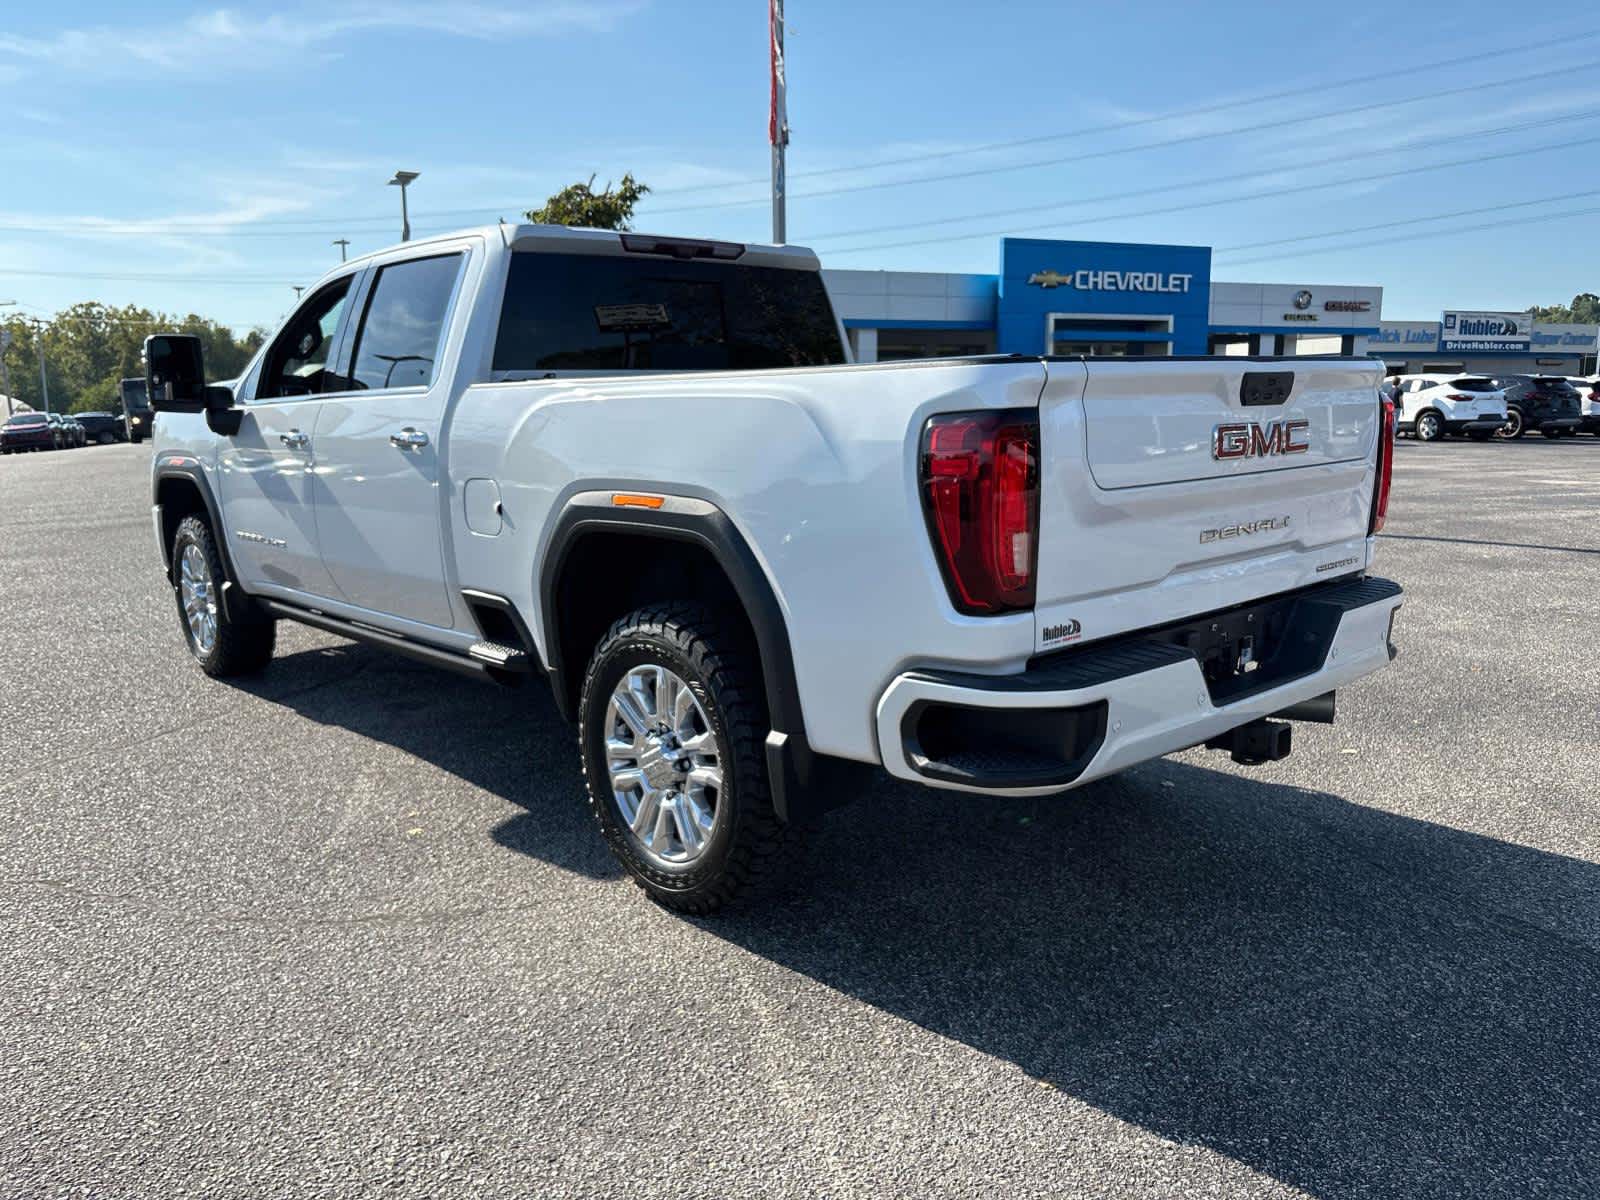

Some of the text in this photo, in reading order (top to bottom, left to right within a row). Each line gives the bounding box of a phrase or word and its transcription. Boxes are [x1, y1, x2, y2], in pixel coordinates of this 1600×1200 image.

[1074, 270, 1192, 293] CHEVROLET
[1459, 319, 1503, 336] Hubler
[1446, 341, 1524, 350] DriveHubler.com
[1212, 419, 1309, 460] GMC
[1199, 515, 1291, 544] DENALI
[1042, 623, 1074, 641] Hubler
